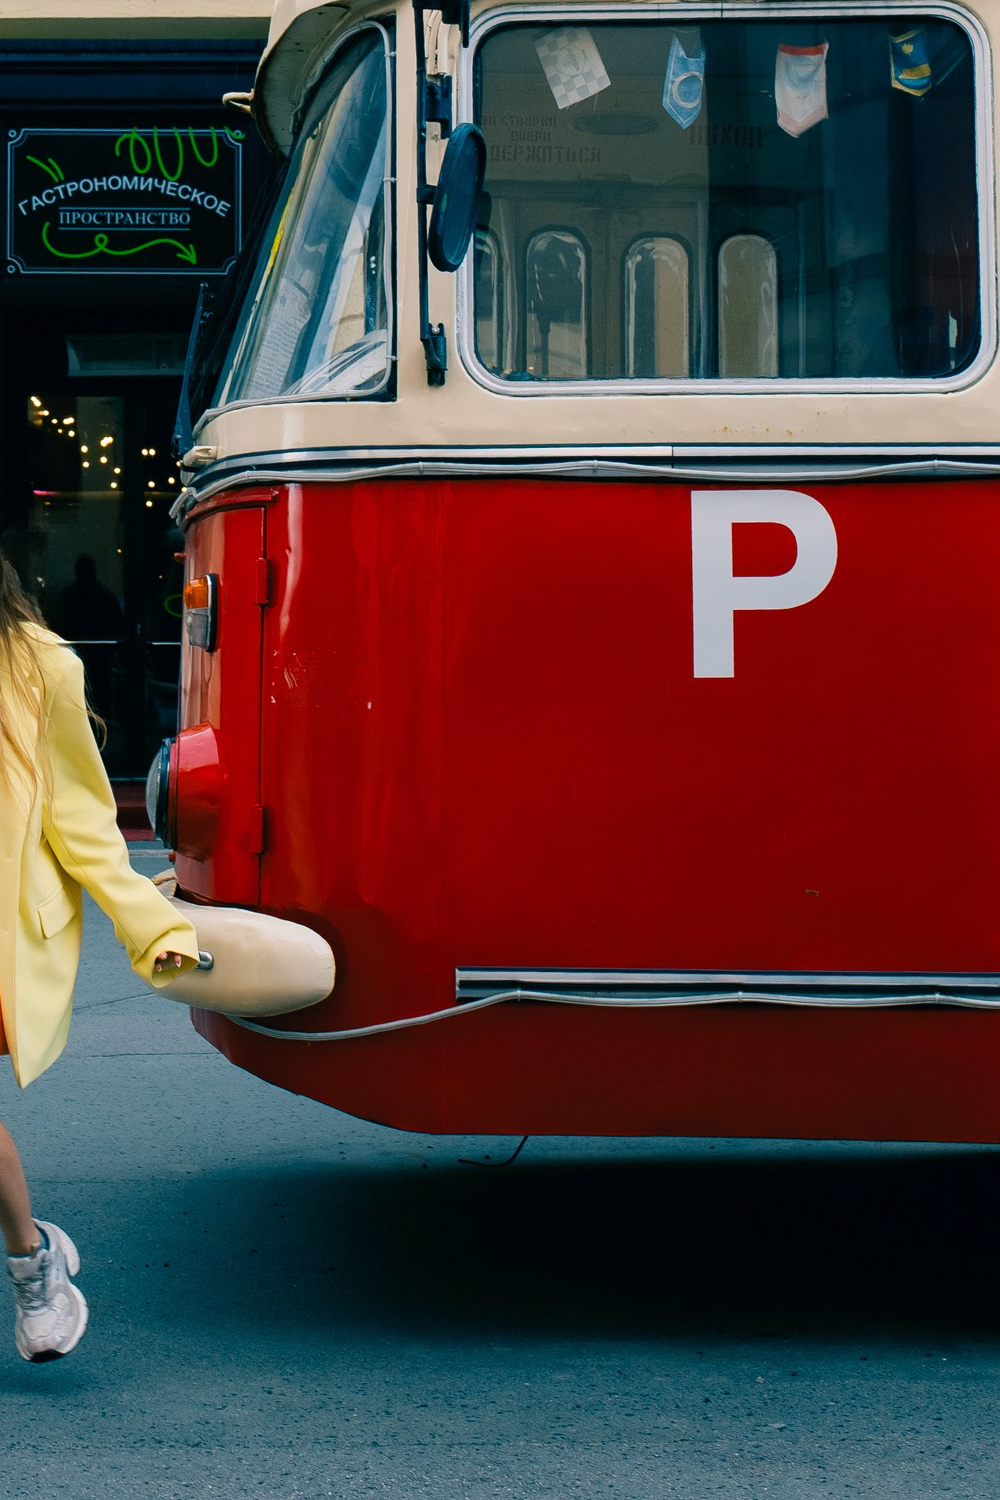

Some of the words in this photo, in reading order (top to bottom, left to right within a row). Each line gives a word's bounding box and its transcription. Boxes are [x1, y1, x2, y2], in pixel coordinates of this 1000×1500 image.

[689, 124, 763, 149] ВЫХОД
[489, 144, 601, 163] ДЕРЖАТЬСЯ
[18, 175, 232, 217] ГАСТРОНОМИЧЕСКОЕ
[58, 211, 191, 225] ПРОСТРАНСТВО
